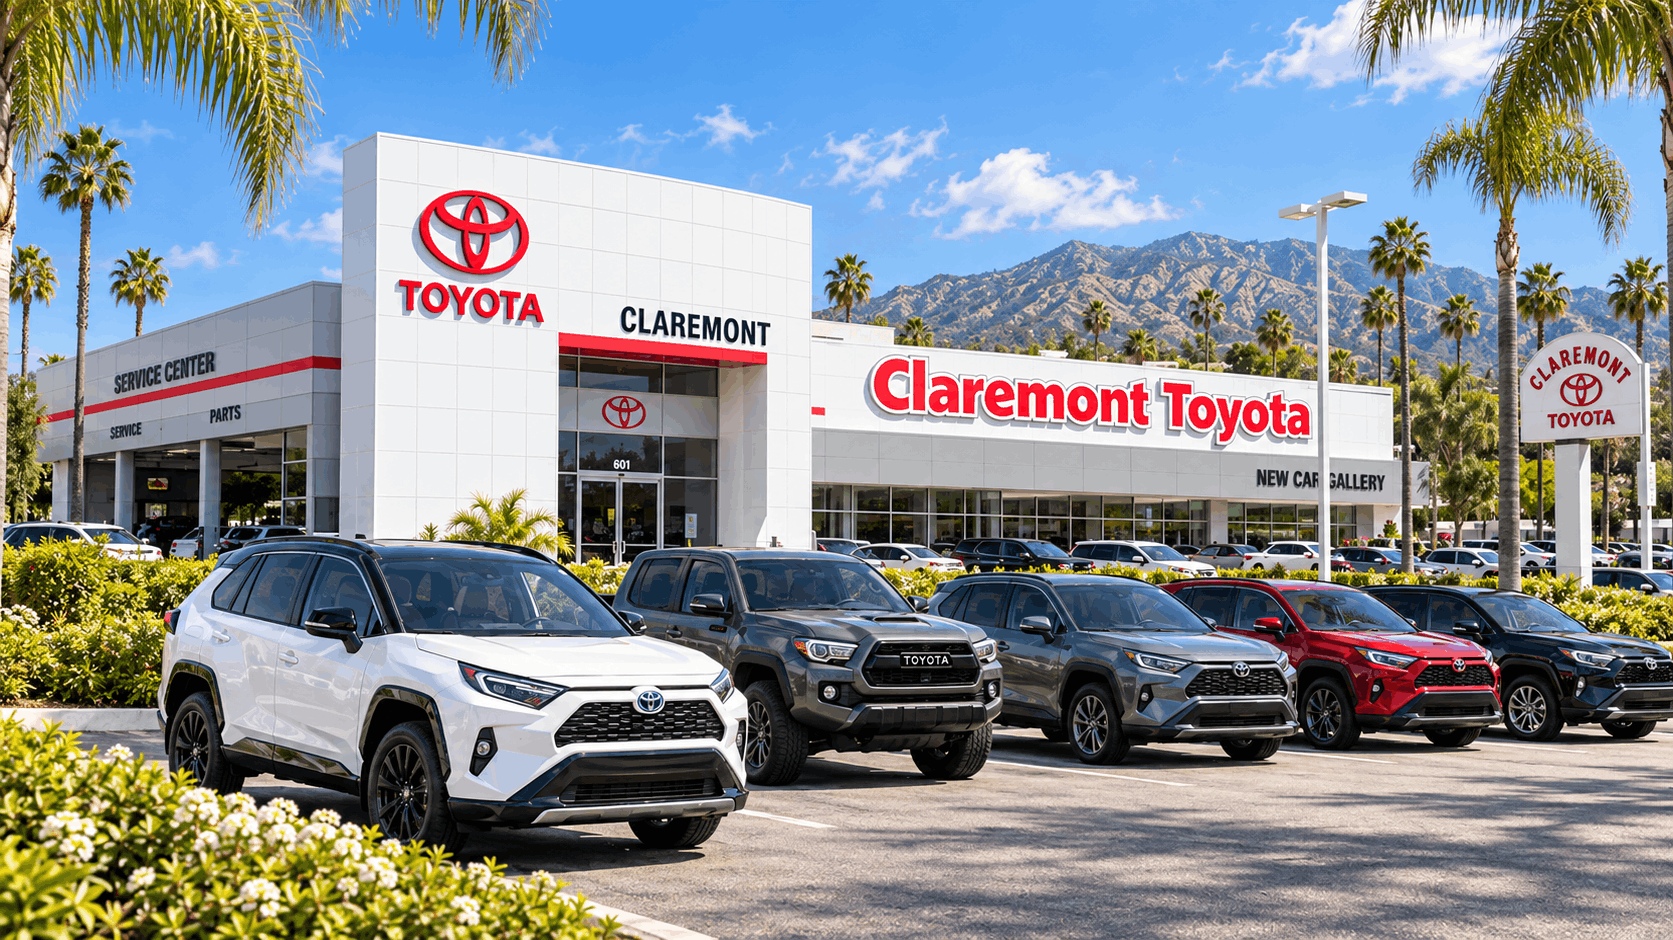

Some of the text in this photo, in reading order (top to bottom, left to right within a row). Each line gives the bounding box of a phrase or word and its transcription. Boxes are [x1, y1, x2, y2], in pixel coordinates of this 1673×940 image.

[398, 279, 545, 323] TOYOTA
[620, 306, 771, 346] CLAREMONT
[114, 351, 216, 395] SERVICE CENTER
[1529, 345, 1632, 390] CLAREMONT
[873, 358, 1310, 442] Claremont Toyota
[209, 404, 242, 424] PARTS
[1547, 409, 1615, 429] TOYOTA
[109, 421, 142, 440] SERVICE
[613, 459, 631, 470] 601
[1256, 469, 1386, 491] NEW CAR GALLERY
[903, 655, 949, 665] TOYOTA
